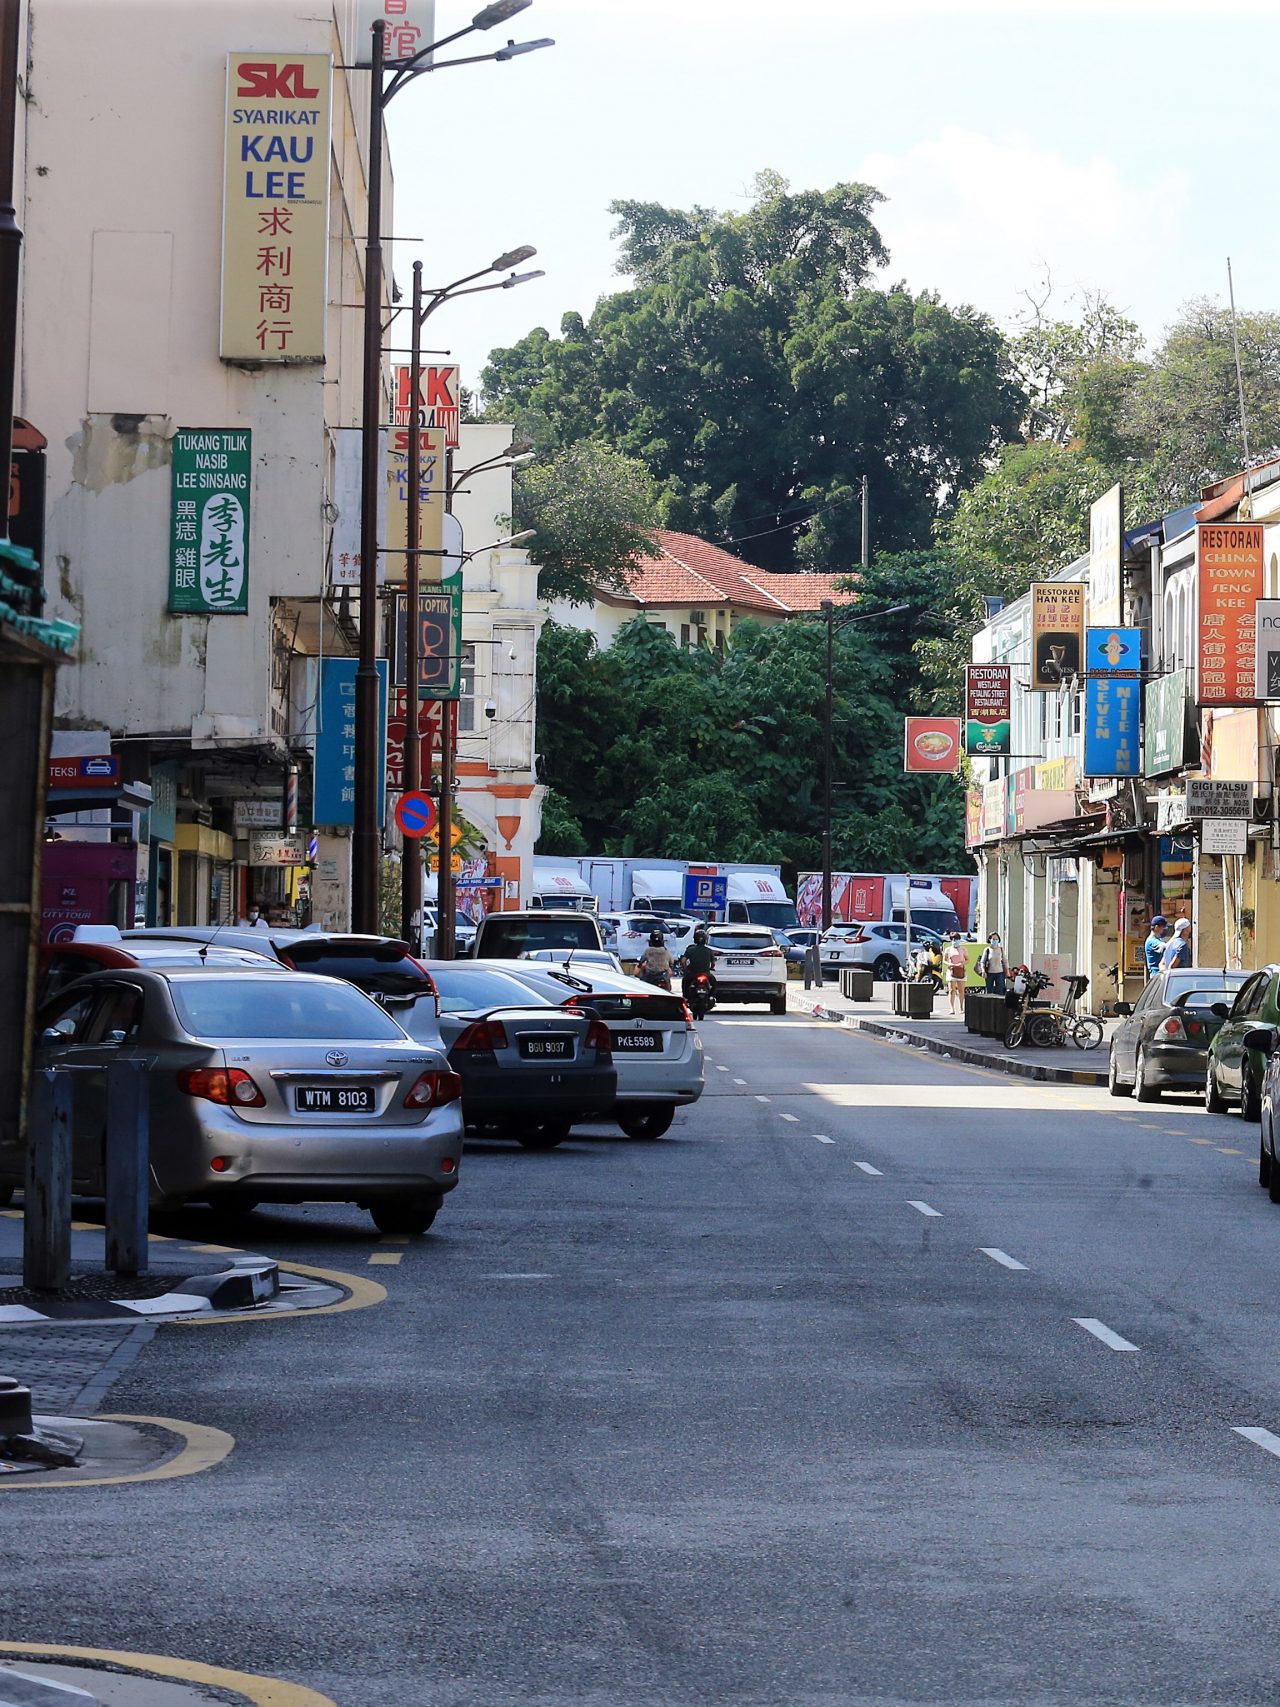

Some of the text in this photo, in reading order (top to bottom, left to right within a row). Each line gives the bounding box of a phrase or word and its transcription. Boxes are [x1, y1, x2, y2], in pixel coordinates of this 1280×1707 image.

[237, 63, 320, 98] SKL
[233, 109, 320, 125] SYARIKAT
[241, 135, 314, 163] KAU
[246, 171, 305, 199] LEE
[256, 207, 294, 350] 求利商行
[399, 367, 454, 406] KK
[177, 435, 247, 451] TUKANG TILIK
[196, 454, 228, 469] NASIB
[177, 473, 246, 489] LEE SINSANG
[1202, 530, 1260, 549] RESTORAN
[202, 497, 240, 603] 李先生
[1205, 553, 1257, 563] CHINA
[1208, 568, 1256, 578] TOWN
[1211, 583, 1252, 593] SENG
[425, 599, 448, 614] OPTIK
[1216, 598, 1246, 608] KEE
[970, 668, 1008, 679] RESTORAN
[50, 767, 77, 777] TEKSI
[1192, 782, 1248, 791] GIGI PALSU
[65, 911, 91, 919] TOUR
[528, 1042, 565, 1053] BGU 9037
[306, 1091, 367, 1106] WTM 8103
